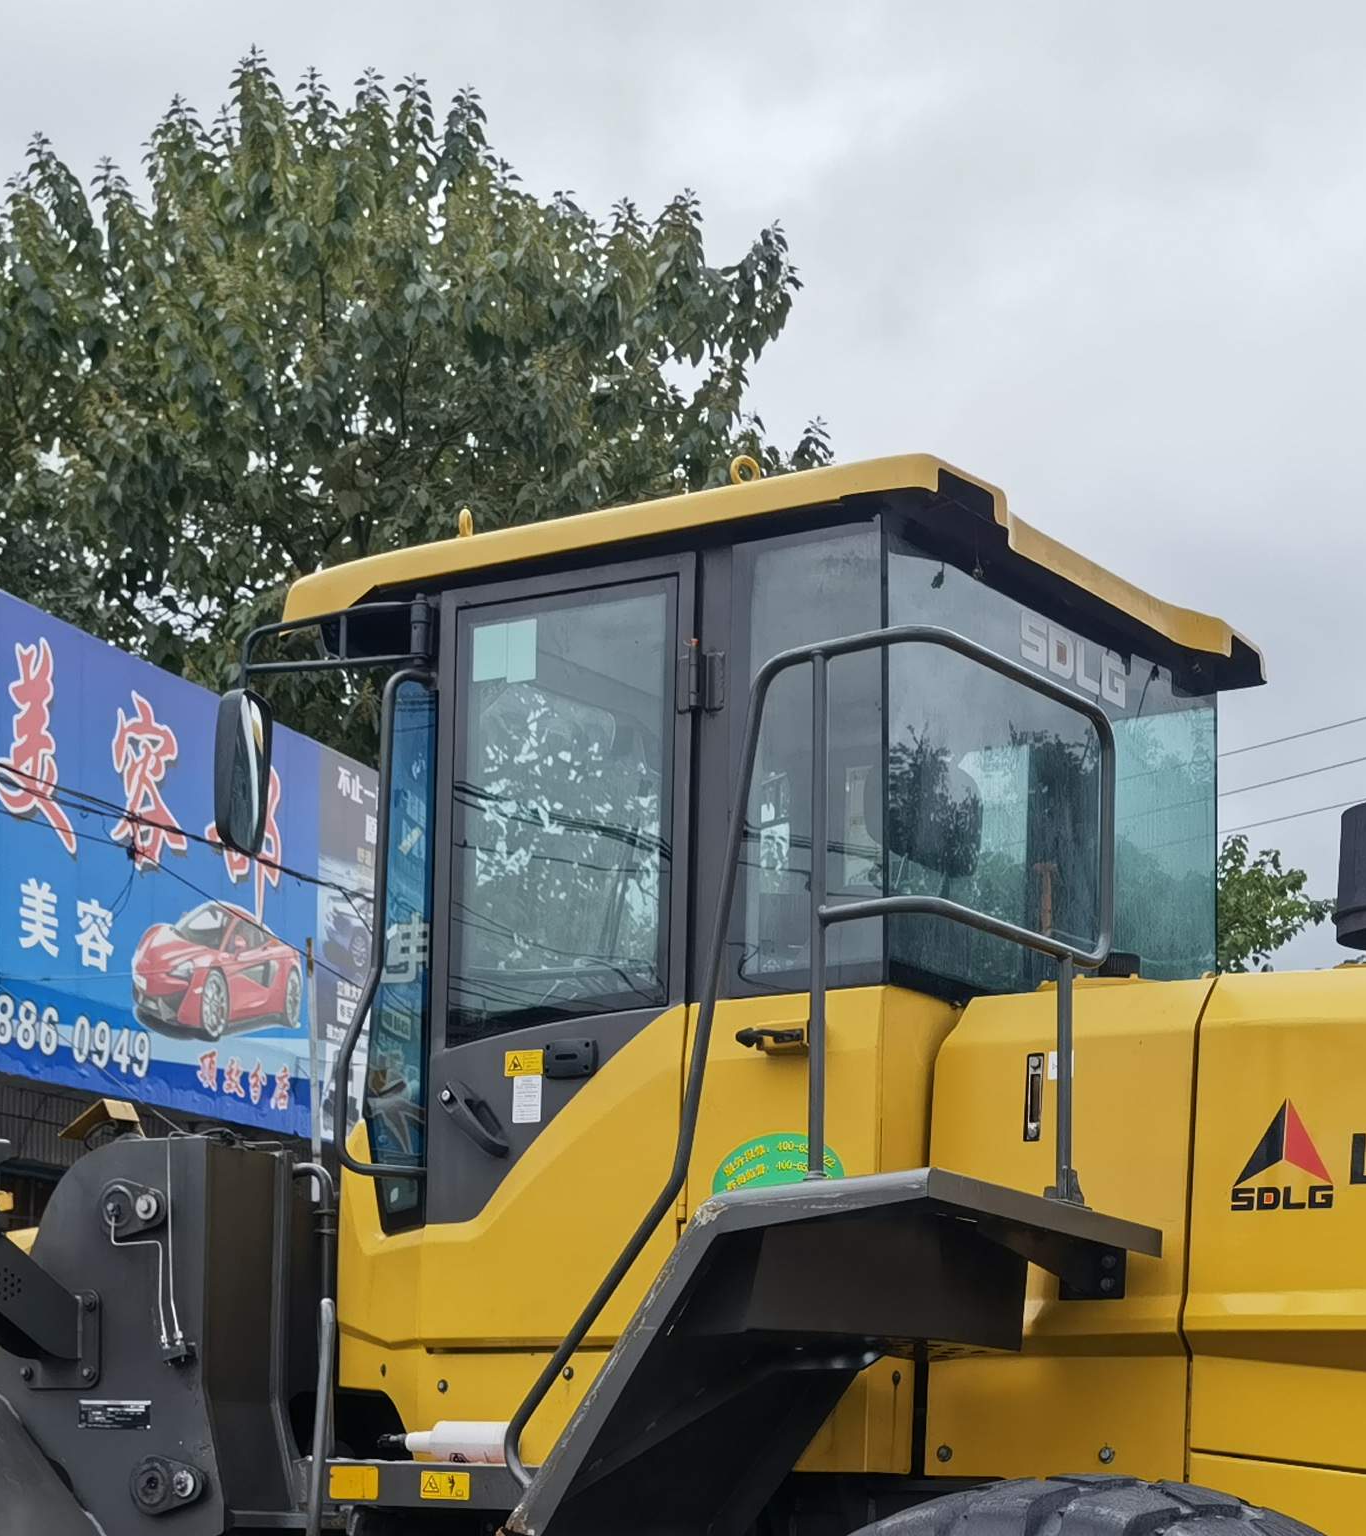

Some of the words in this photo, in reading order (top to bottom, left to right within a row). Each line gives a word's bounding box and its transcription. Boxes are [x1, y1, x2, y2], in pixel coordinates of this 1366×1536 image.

[1020, 609, 1126, 709] SDLG
[73, 1015, 150, 1078] 0949
[1230, 1185, 1334, 1212] SDLG
